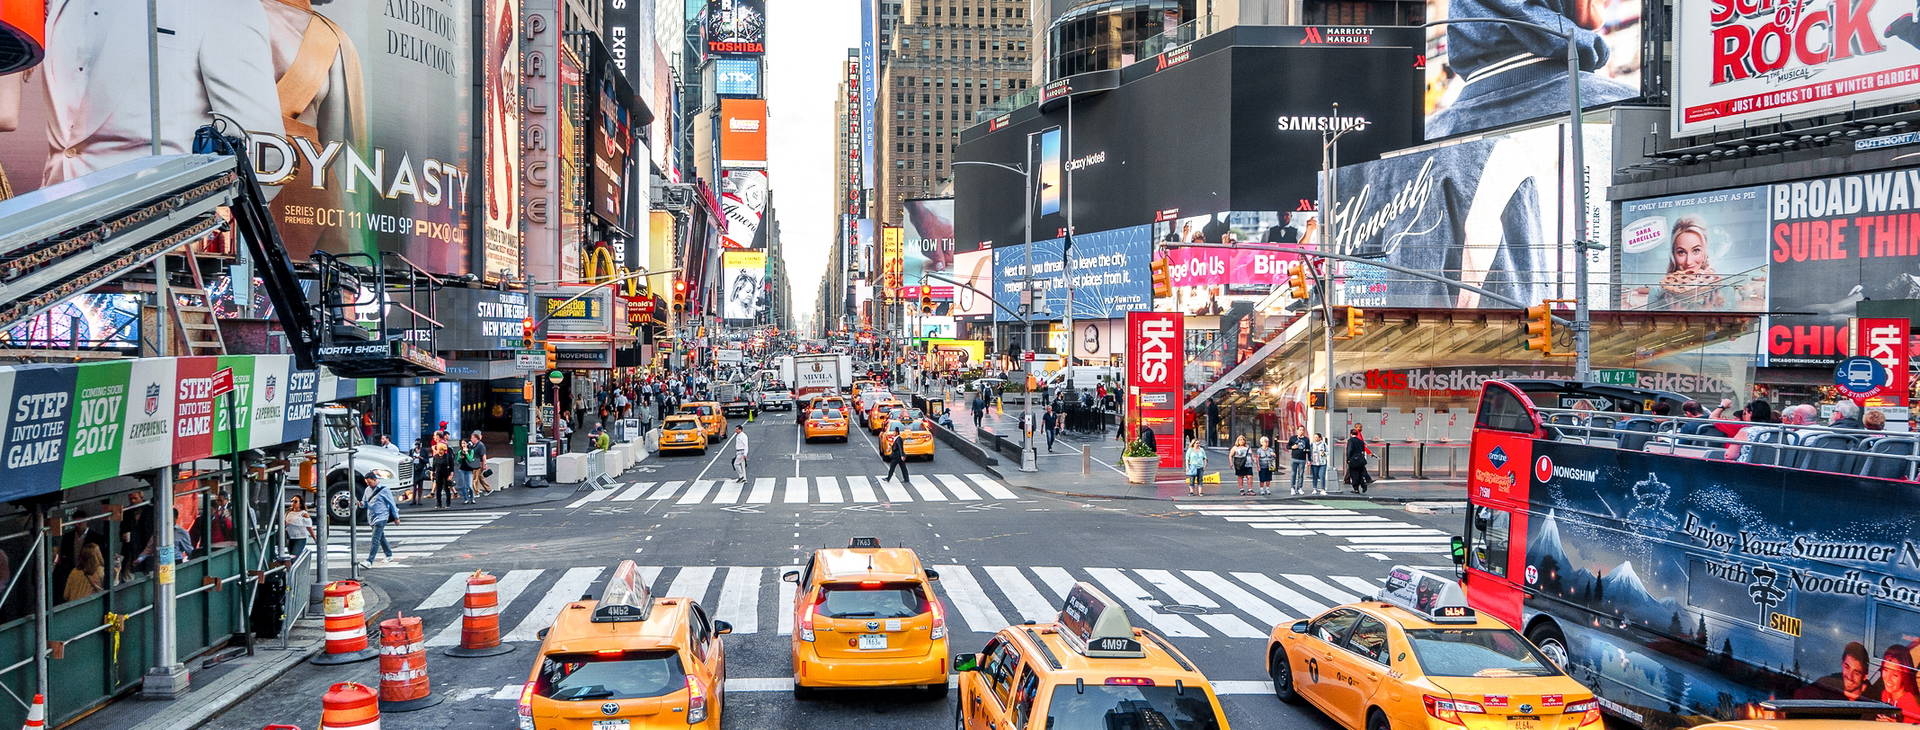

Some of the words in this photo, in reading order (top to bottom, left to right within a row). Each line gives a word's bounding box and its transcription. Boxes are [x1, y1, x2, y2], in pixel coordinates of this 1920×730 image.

[384, 0, 456, 43] AMBITIOUS
[1775, 0, 1805, 33] of
[386, 29, 456, 79] DELICIOUS
[612, 26, 626, 78] EXPR
[709, 40, 764, 52] TOSHIBA
[1711, 0, 1886, 87] ROCK
[864, 41, 872, 81] NINJAS
[728, 71, 754, 81] TDK
[1778, 68, 1809, 82] MUSICAL
[1732, 98, 1754, 112] JUST
[1756, 97, 1762, 108] 4
[1764, 91, 1798, 107] BLOCKS
[1801, 88, 1813, 100] TO
[1815, 85, 1832, 98] THE
[1835, 76, 1874, 94] WINTER
[1877, 69, 1919, 87] GARDEN
[526, 13, 547, 224] PALACE
[1278, 116, 1365, 131] SAMSUNG
[249, 131, 469, 214] DYNASTY
[1330, 156, 1443, 256] Honestly
[1638, 203, 1656, 211] ONLY
[1658, 201, 1673, 209] LIFE
[1674, 199, 1696, 208] WERE
[1709, 195, 1729, 203] EASY
[1774, 170, 1920, 220] BROADWAY
[285, 205, 314, 217] SERIES
[317, 207, 345, 226] OCT
[349, 212, 362, 229] 11
[367, 213, 396, 234] WED
[399, 217, 413, 234] 9P
[285, 216, 313, 225] PREMIERE
[1636, 227, 1652, 237] SARA
[1773, 219, 1848, 263] SURE
[908, 239, 938, 252] KNOW
[1004, 265, 1018, 278] Next
[1032, 263, 1043, 276] you
[1079, 254, 1097, 269] leave
[1098, 253, 1111, 267] the
[1112, 252, 1127, 268] city,
[1191, 258, 1207, 277] On
[1209, 255, 1225, 275] Us
[1053, 276, 1064, 288] the
[1082, 274, 1103, 289] places
[1104, 271, 1121, 286] from
[478, 302, 496, 317] STAY
[495, 303, 503, 318] IN
[503, 304, 513, 318] THE
[482, 321, 499, 336] NEW
[318, 346, 351, 355] NORTH
[354, 345, 389, 354] SHORE
[1142, 317, 1174, 383] tkts
[290, 373, 315, 390] STEP
[1602, 372, 1610, 382] W
[1614, 371, 1625, 382] 47
[82, 387, 106, 398] COMING
[106, 384, 124, 395] SOON
[180, 377, 212, 400] STEP
[289, 393, 302, 402] INTO
[302, 391, 314, 401] THE
[1847, 386, 1881, 398] STANDING
[15, 391, 69, 422] STEP
[78, 395, 122, 429] NOV
[179, 403, 197, 416] INTO
[197, 401, 211, 413] THE
[256, 405, 280, 421] EXPERIENCE
[287, 403, 312, 422] GAME
[129, 419, 168, 440] EXPERIENCE
[178, 416, 210, 437] GAME
[218, 406, 249, 432] 217
[12, 423, 41, 443] INTO
[42, 421, 65, 437] THE
[73, 424, 118, 458] 2017
[7, 439, 62, 470] GAME
[1553, 465, 1595, 483] NONGSHIM
[1683, 512, 1736, 554] Enjoy
[1738, 531, 1787, 558] Your
[1791, 535, 1895, 564] Summer
[1705, 558, 1749, 584] with
[1788, 568, 1870, 596] Noodle
[1770, 612, 1801, 637] SHIN
[1101, 639, 1128, 650] 4M97
